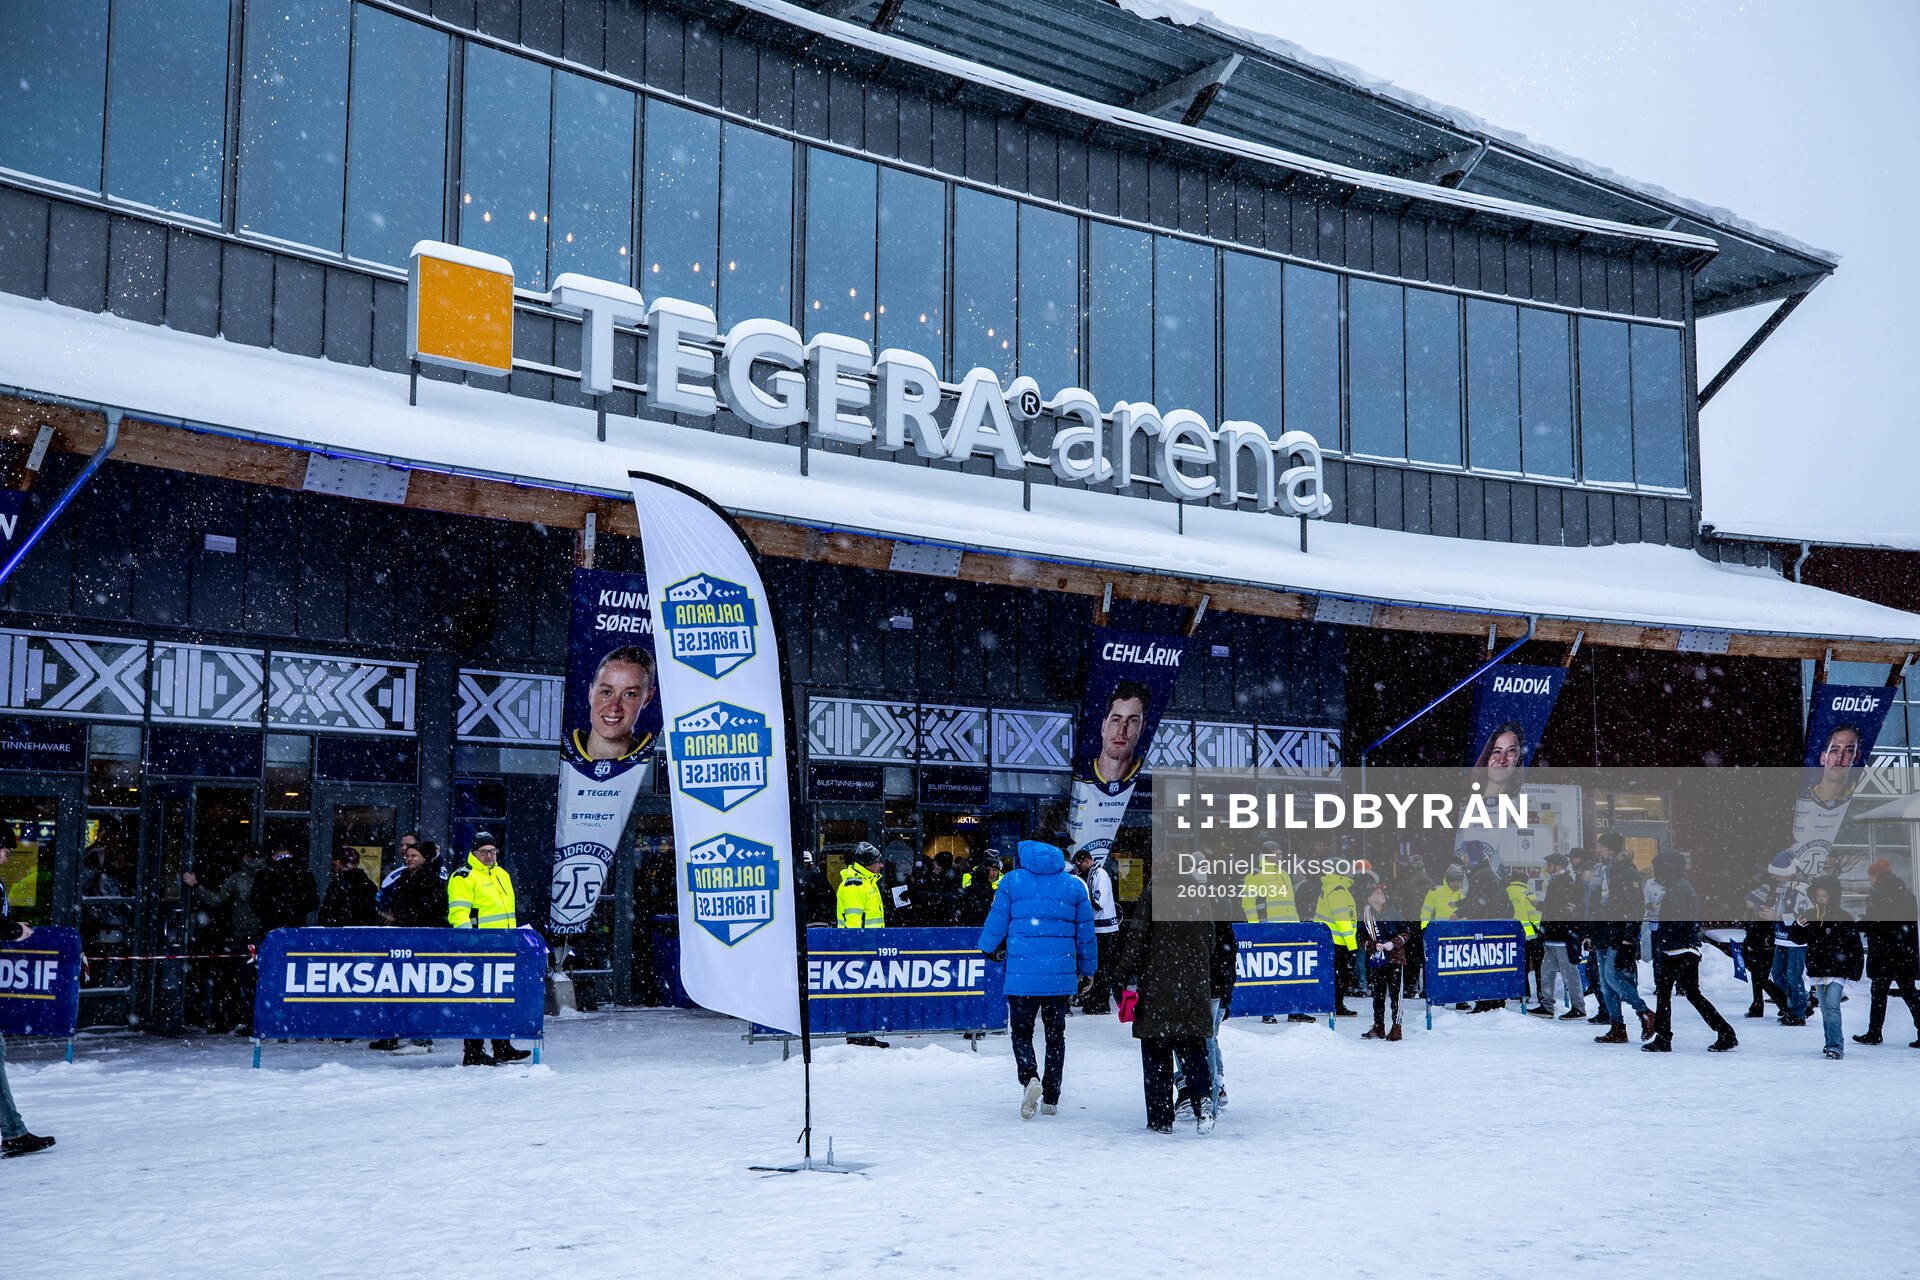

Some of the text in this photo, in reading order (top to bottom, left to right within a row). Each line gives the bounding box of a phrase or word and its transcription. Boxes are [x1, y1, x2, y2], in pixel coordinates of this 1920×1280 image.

[1049, 394, 1333, 517] arena
[599, 590, 651, 610] KUNN
[594, 613, 654, 634] SØREN
[1102, 642, 1183, 667] CEHLÁRIK
[1493, 675, 1552, 695] RADOVÁ
[1831, 695, 1880, 712] GIDLÖF
[390, 949, 412, 959] 1919
[878, 948, 897, 956] 1919
[1238, 941, 1252, 949] 1919
[1438, 942, 1518, 968] LEKSANDS IF
[34, 960, 58, 990] IF
[958, 958, 985, 988] IF
[1297, 951, 1318, 976] IF
[285, 962, 515, 994] LEKSANDS IF
